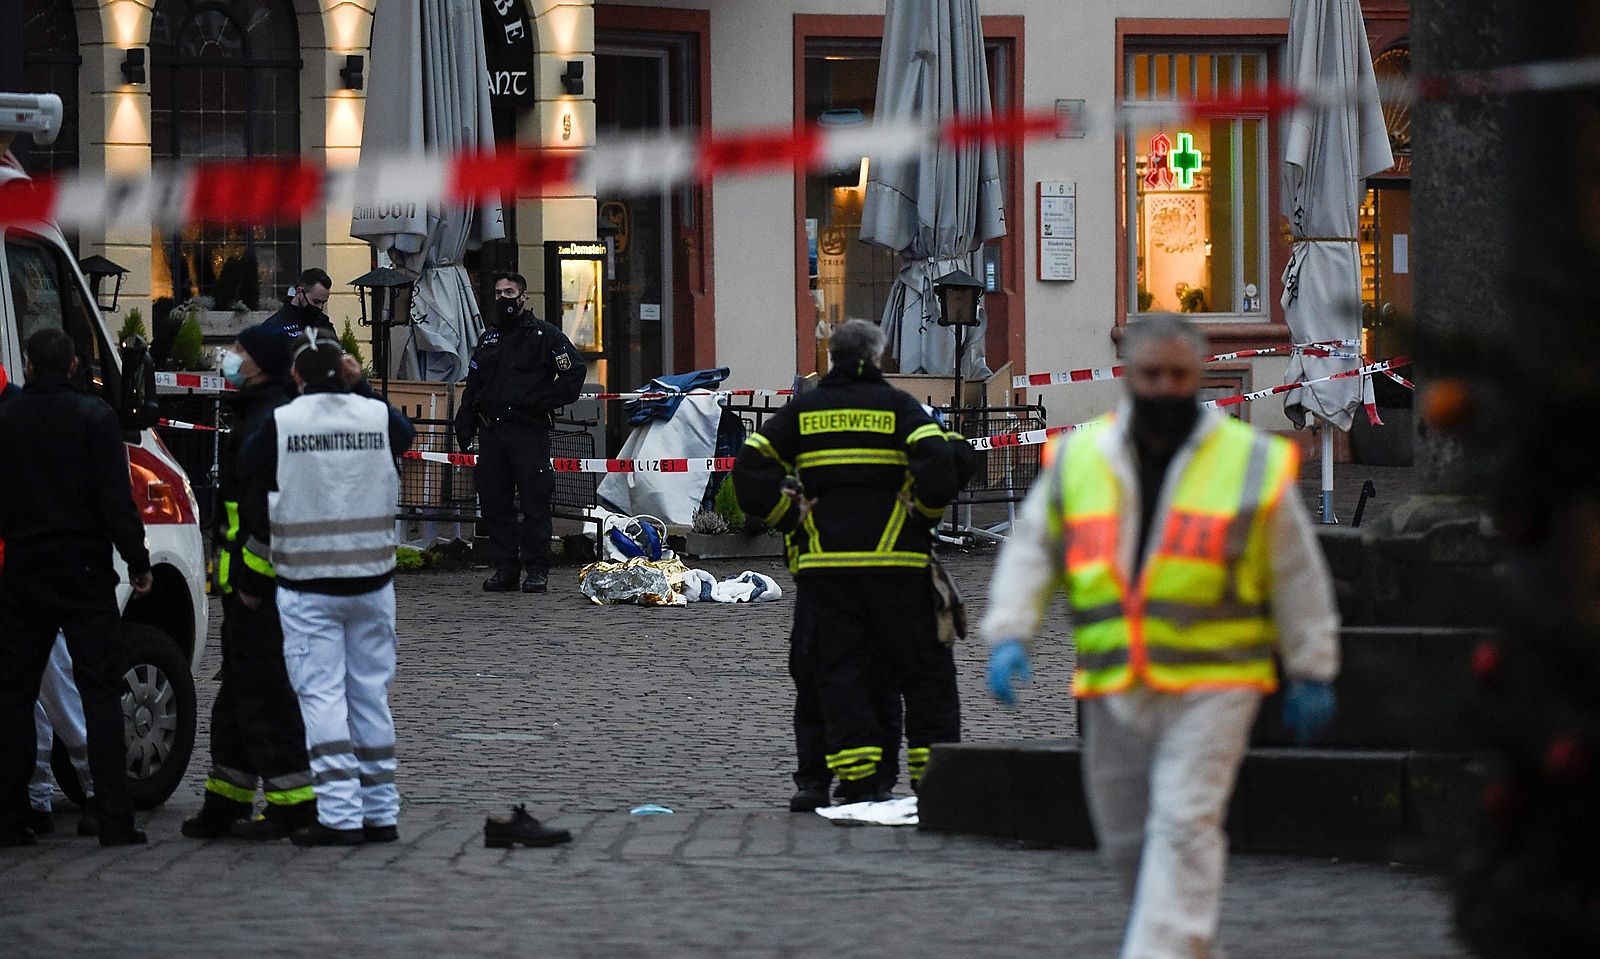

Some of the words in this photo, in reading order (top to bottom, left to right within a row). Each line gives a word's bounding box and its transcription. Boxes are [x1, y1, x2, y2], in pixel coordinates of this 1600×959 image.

[558, 246, 571, 255] Zum
[570, 243, 607, 255] Domstein
[801, 411, 894, 431] FEUERWEHR
[287, 432, 386, 453] ABSCHNITTSLEITER
[971, 432, 1030, 450] POLIZEI
[618, 460, 675, 471] POLIZEI
